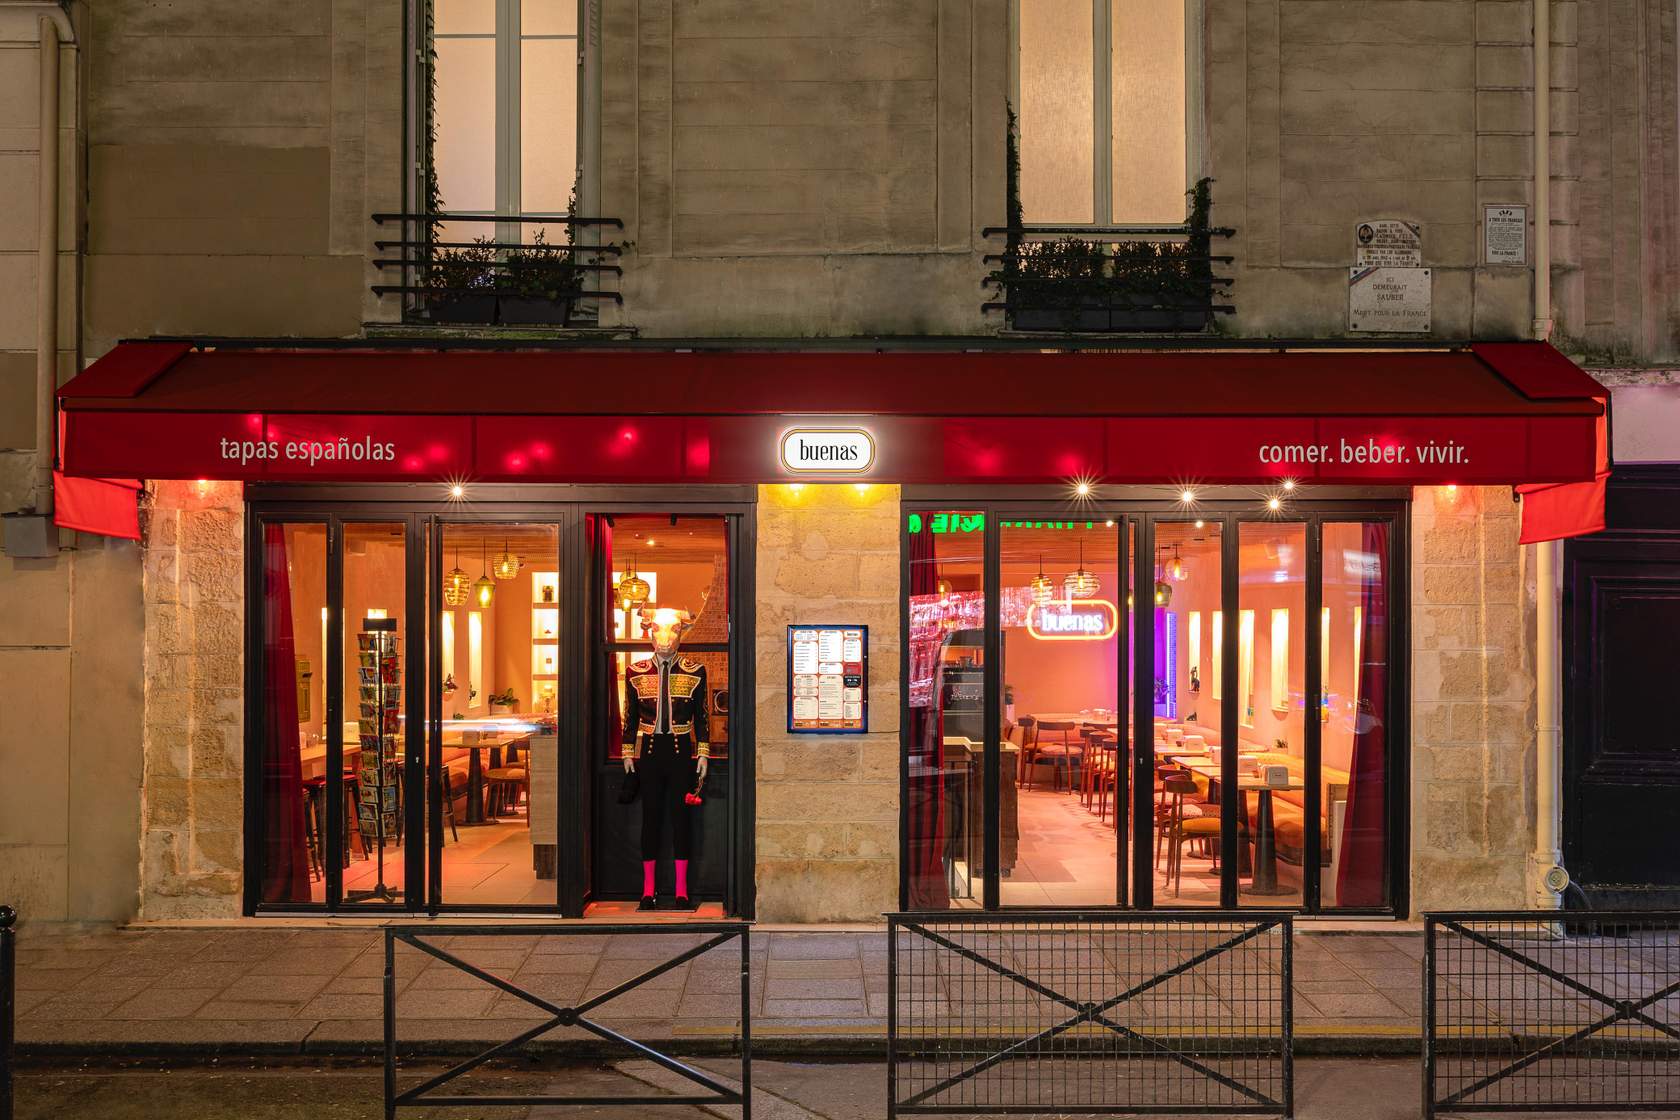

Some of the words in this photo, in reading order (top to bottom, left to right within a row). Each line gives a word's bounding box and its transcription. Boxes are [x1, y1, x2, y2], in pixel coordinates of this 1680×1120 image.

[220, 437, 279, 466] tapas
[285, 435, 395, 467] españolas
[800, 439, 858, 460] buenas
[1259, 444, 1334, 464] comer.
[1340, 438, 1411, 464] beber.
[1416, 440, 1470, 464] vivir.
[1041, 608, 1104, 631] buenas
